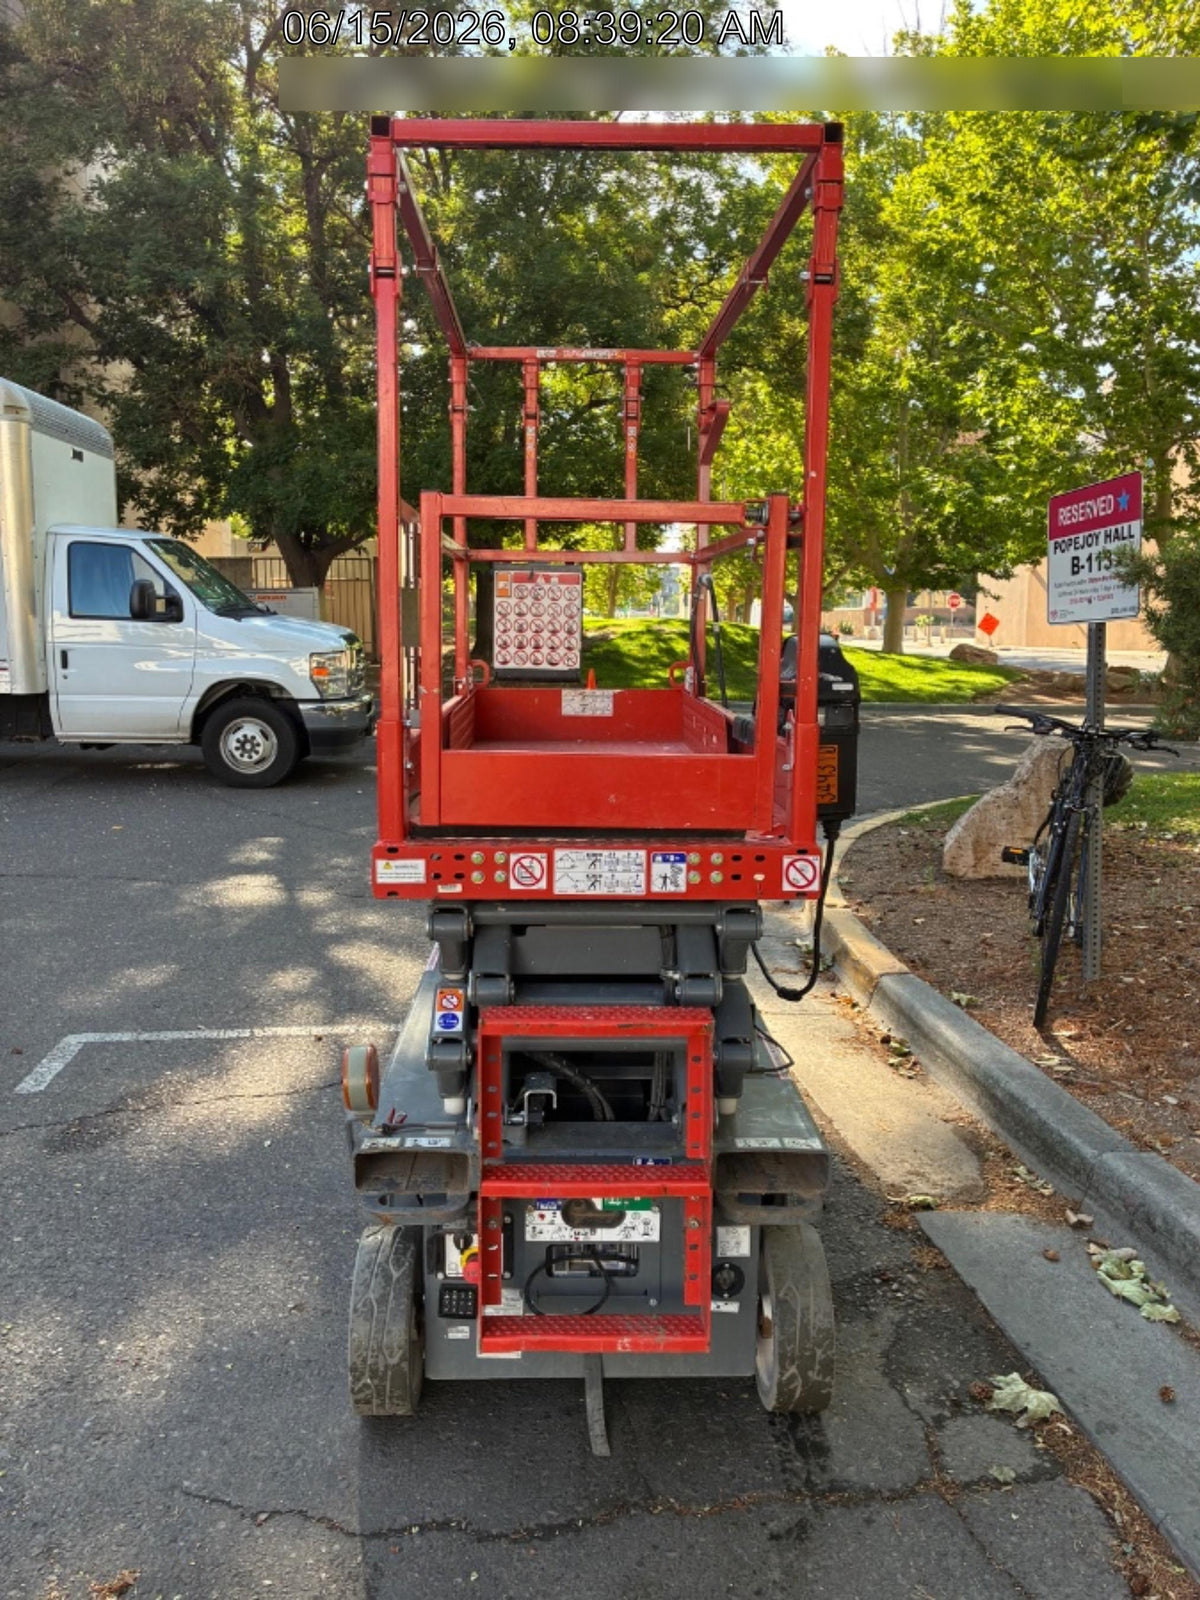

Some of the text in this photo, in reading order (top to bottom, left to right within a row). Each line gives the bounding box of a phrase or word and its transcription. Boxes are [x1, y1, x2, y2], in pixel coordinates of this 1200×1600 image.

[1058, 494, 1114, 526] RESERVED
[1053, 524, 1135, 555] POPEJOY HALL
